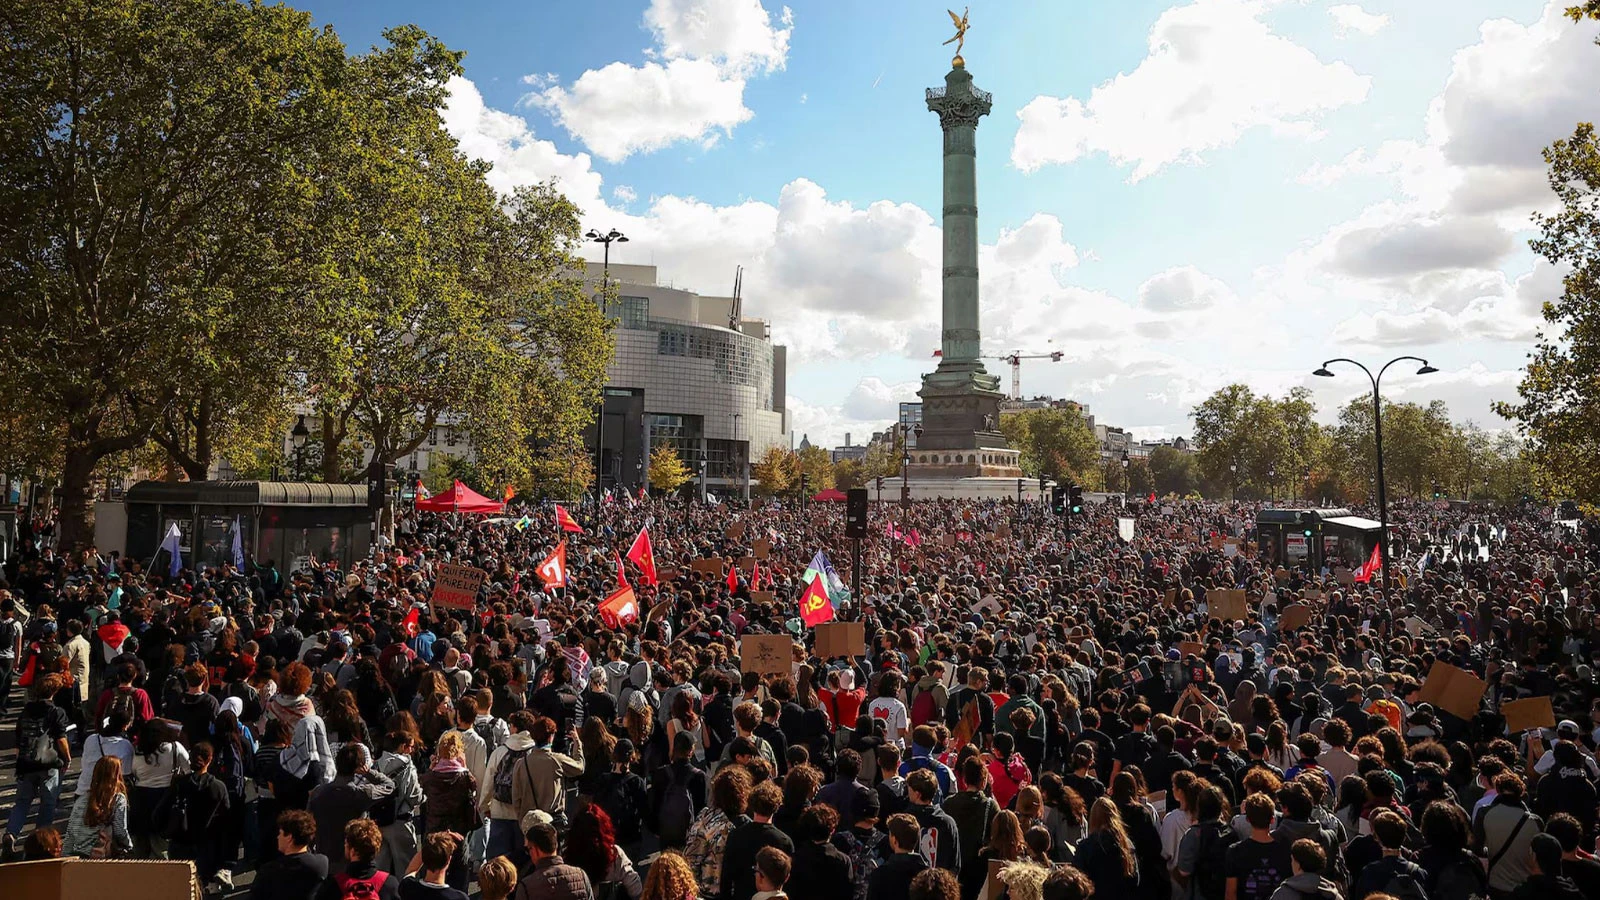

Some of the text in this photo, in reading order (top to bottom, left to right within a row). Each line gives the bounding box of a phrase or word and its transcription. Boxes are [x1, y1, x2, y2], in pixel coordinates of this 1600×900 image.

[442, 566, 480, 581] QUI FERA
[440, 575, 462, 589] TAIRE
